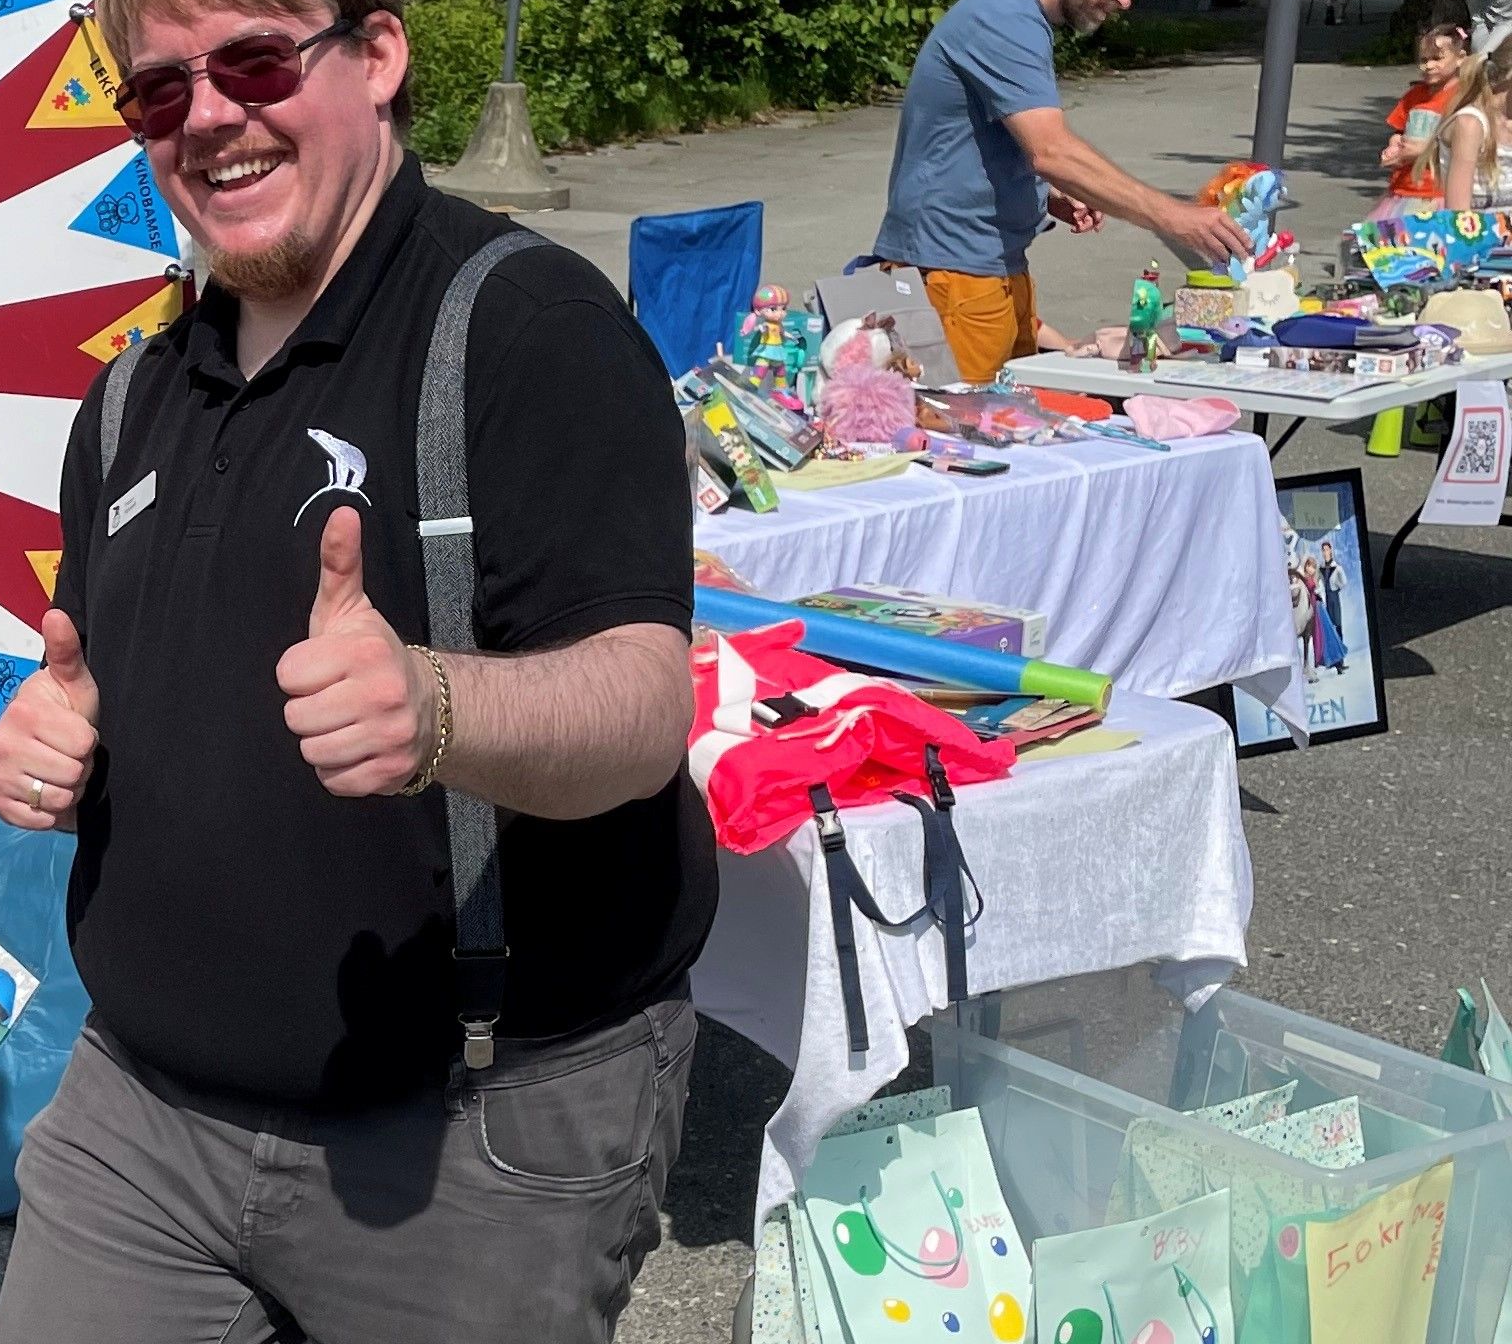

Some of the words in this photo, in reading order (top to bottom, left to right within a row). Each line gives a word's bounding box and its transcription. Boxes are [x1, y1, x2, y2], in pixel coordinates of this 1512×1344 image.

[89, 57, 117, 99] LEKE
[134, 158, 163, 251] KINOBAMSE
[1327, 1239, 1372, 1288] 50
